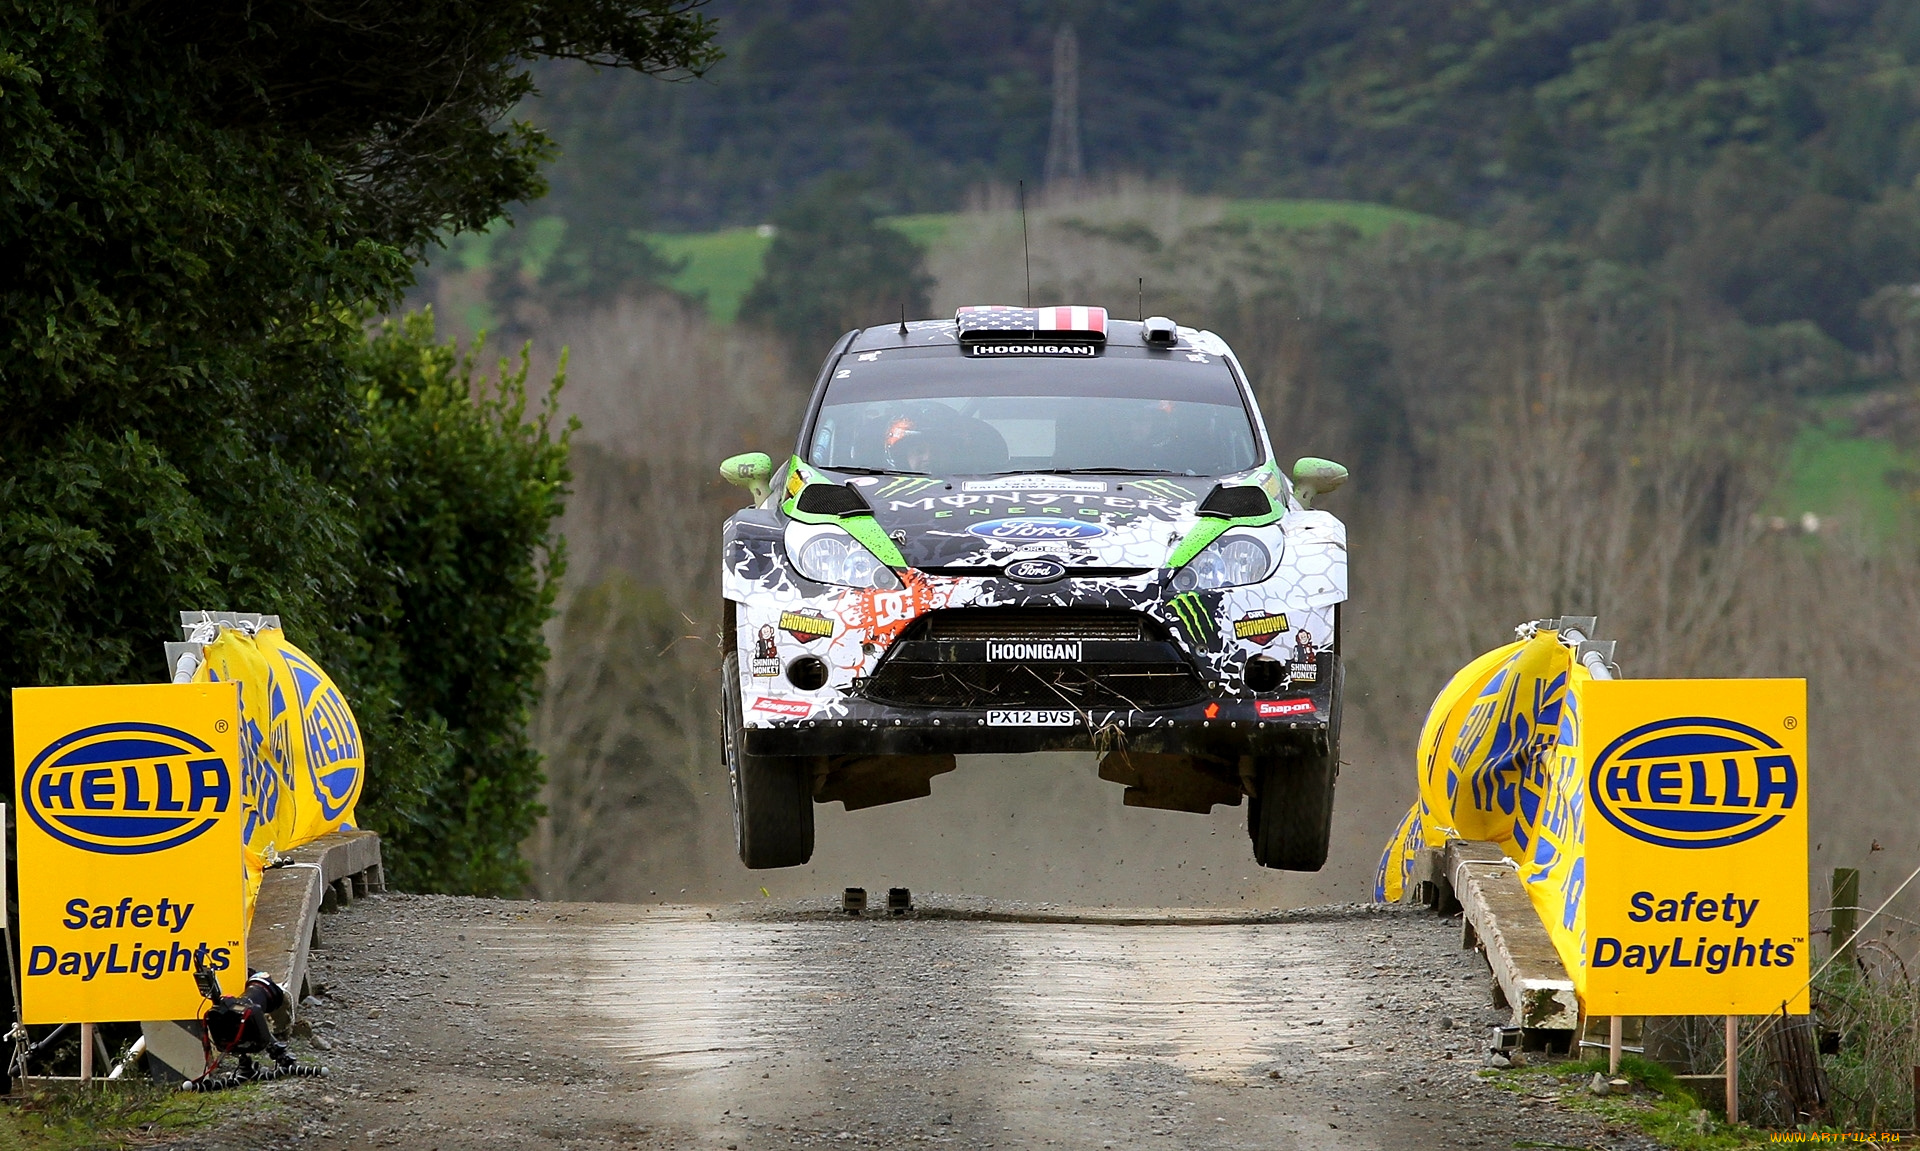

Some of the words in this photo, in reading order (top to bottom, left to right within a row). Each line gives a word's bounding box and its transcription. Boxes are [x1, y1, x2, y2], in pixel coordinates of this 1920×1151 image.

[836, 369, 852, 379] 2
[888, 491, 1182, 515] MONSTER
[935, 506, 1134, 518] ENERGY
[992, 518, 1081, 538] Ford
[1017, 562, 1052, 576] Ford
[874, 586, 916, 627] DC
[780, 612, 834, 636] SHOWDOWN
[1234, 615, 1288, 638] SHOWDOWN
[753, 658, 779, 667] SHINING
[753, 666, 779, 674] MONKEY
[1290, 663, 1317, 672] SHINING
[1290, 671, 1317, 680] MONKEY
[756, 700, 809, 713] Snap-on
[1260, 703, 1311, 714] Snap-on
[990, 711, 1032, 724] PX12
[1037, 711, 1071, 724] BVS
[306, 687, 360, 769] HELLA
[38, 758, 231, 812] HELLA
[1606, 755, 1798, 809] HELLA
[62, 897, 195, 933] Safety
[1627, 891, 1760, 928] Safety
